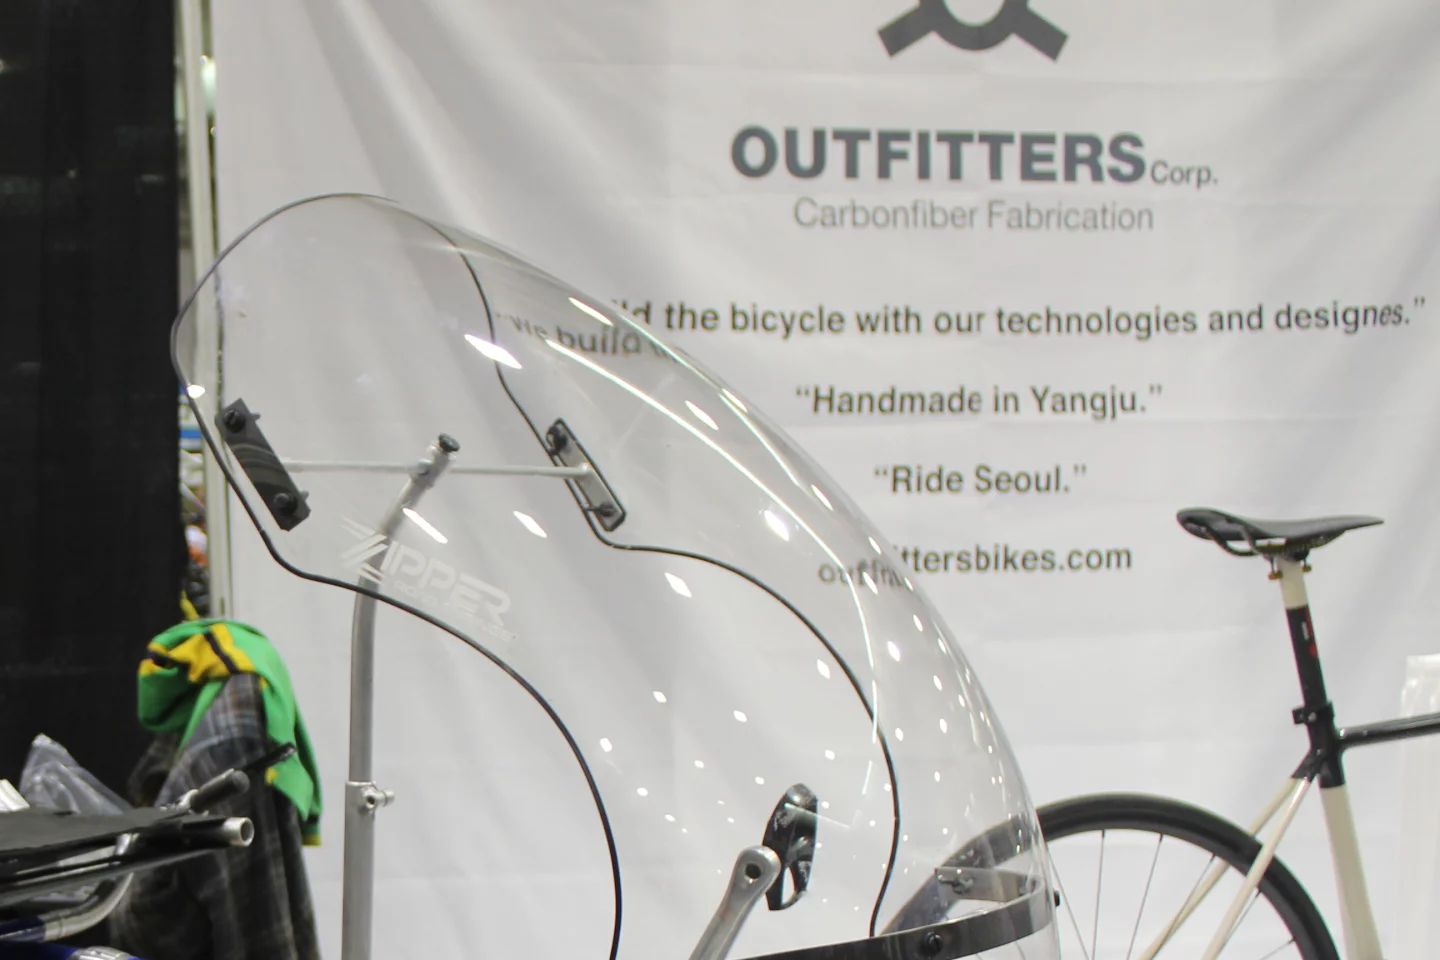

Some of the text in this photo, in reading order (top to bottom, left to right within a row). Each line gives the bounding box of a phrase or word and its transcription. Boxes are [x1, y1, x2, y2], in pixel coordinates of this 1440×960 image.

[730, 124, 1219, 190] OUTFITTERS Corp.
[793, 196, 1154, 232] Carbonfiber Fabrication
[665, 302, 720, 332] the
[730, 304, 846, 340] bicycle
[856, 305, 923, 334] with
[933, 310, 985, 334] our
[996, 304, 1199, 341] technologies
[1208, 302, 1264, 331] and
[993, 385, 1020, 414] in
